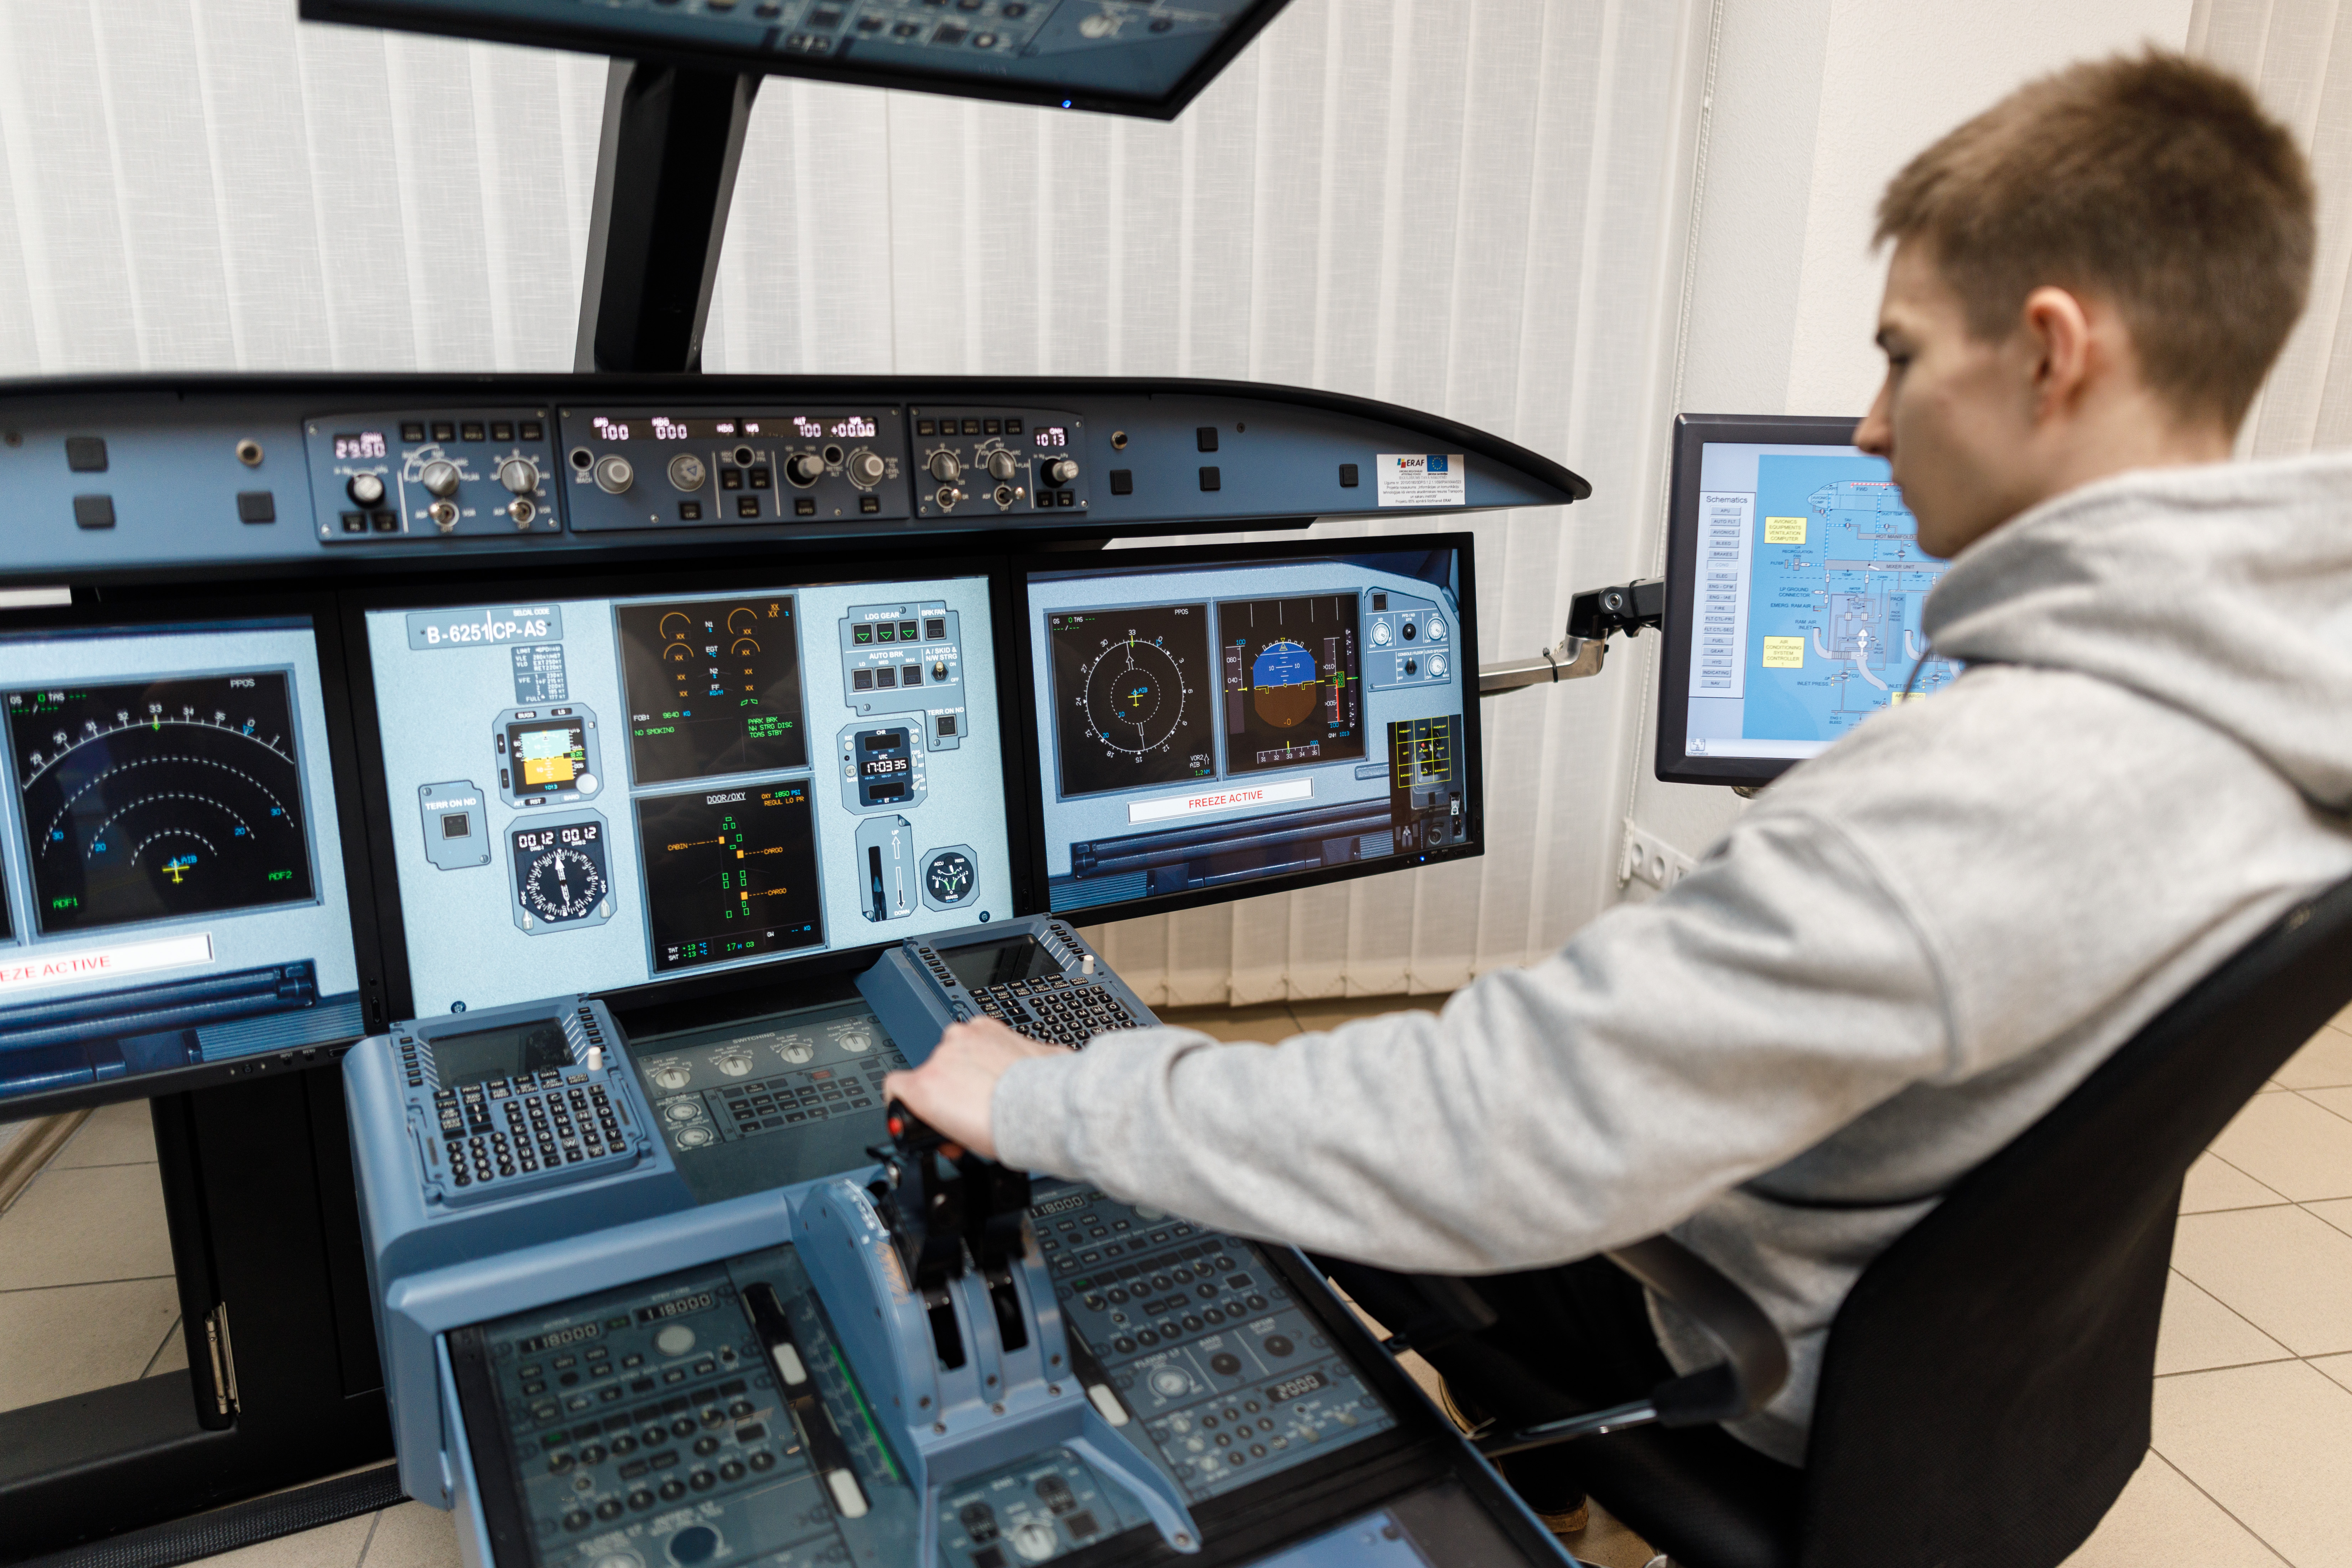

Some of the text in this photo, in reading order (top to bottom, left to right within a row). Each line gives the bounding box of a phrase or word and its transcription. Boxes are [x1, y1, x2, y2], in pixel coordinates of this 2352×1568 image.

[593, 417, 609, 427] SPD
[651, 417, 670, 427] HDG
[793, 416, 806, 425] ALT
[513, 608, 533, 617] SELCAL
[493, 619, 547, 639] CP-AS
[1100, 639, 1108, 647] 30
[1081, 664, 1087, 673] 27
[230, 678, 255, 689] PPOS
[1076, 697, 1081, 706] 24
[149, 703, 162, 713] 33
[647, 727, 675, 735] SMOKING
[867, 759, 907, 773] 17:03 35
[707, 792, 746, 803] DOOR/OXY
[1188, 790, 1263, 809] FREEZE ACTIVE
[425, 797, 477, 811] TERR ON ND
[668, 843, 688, 851] CABIN
[181, 855, 197, 865] AIB
[268, 871, 292, 881] ADF2
[53, 898, 79, 910] ADF1
[0, 955, 111, 982] EZE ACTIVE
[733, 1033, 775, 1044] SWITCHING
